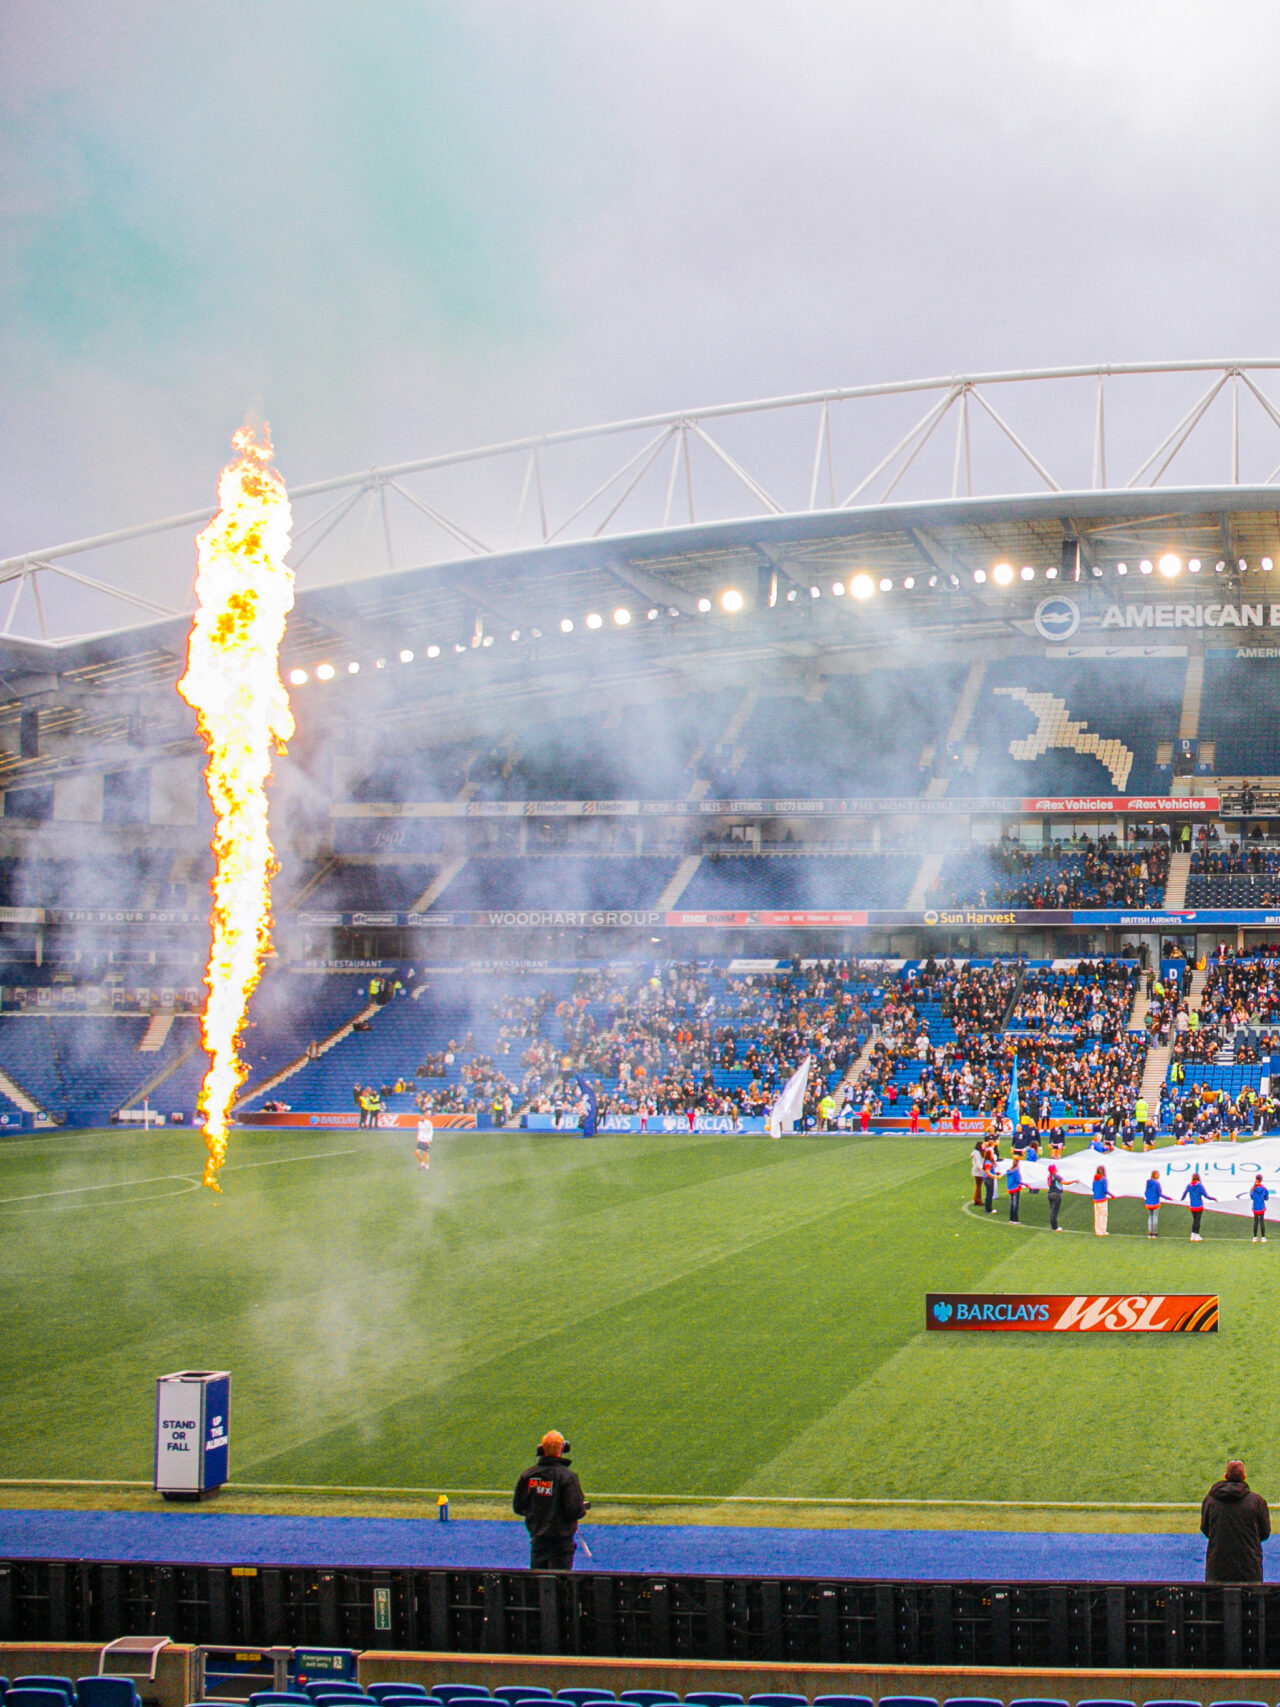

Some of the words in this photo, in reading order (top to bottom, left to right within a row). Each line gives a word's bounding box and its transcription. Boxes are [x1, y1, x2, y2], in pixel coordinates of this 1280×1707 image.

[1101, 604, 1263, 628] AMERICAN
[1182, 740, 1190, 750] D
[1043, 800, 1064, 810] Rex
[1065, 800, 1113, 810] Vehicles
[1134, 799, 1157, 810] Rex
[1157, 799, 1206, 810] Vehicles
[68, 912, 94, 921] THE
[100, 912, 143, 921] FLOUR
[150, 912, 174, 921] POT
[489, 913, 587, 925] WOODHART
[592, 912, 660, 925] GROUP
[940, 912, 966, 924] Sun
[968, 912, 1016, 924] Harvest
[1120, 916, 1150, 924] BRITISH
[1151, 916, 1182, 924] AIRWAYS
[907, 969, 917, 980] C
[1169, 968, 1178, 980] D
[941, 1121, 984, 1129] BACLAYS
[1166, 1162, 1262, 1176] child
[956, 1303, 1050, 1321] BARCLAYS
[1053, 1296, 1170, 1330] WSL
[162, 1420, 196, 1429] STAND
[212, 1416, 222, 1427] UP
[172, 1432, 186, 1440] OR
[210, 1426, 224, 1438] THE
[167, 1443, 190, 1451] FALL
